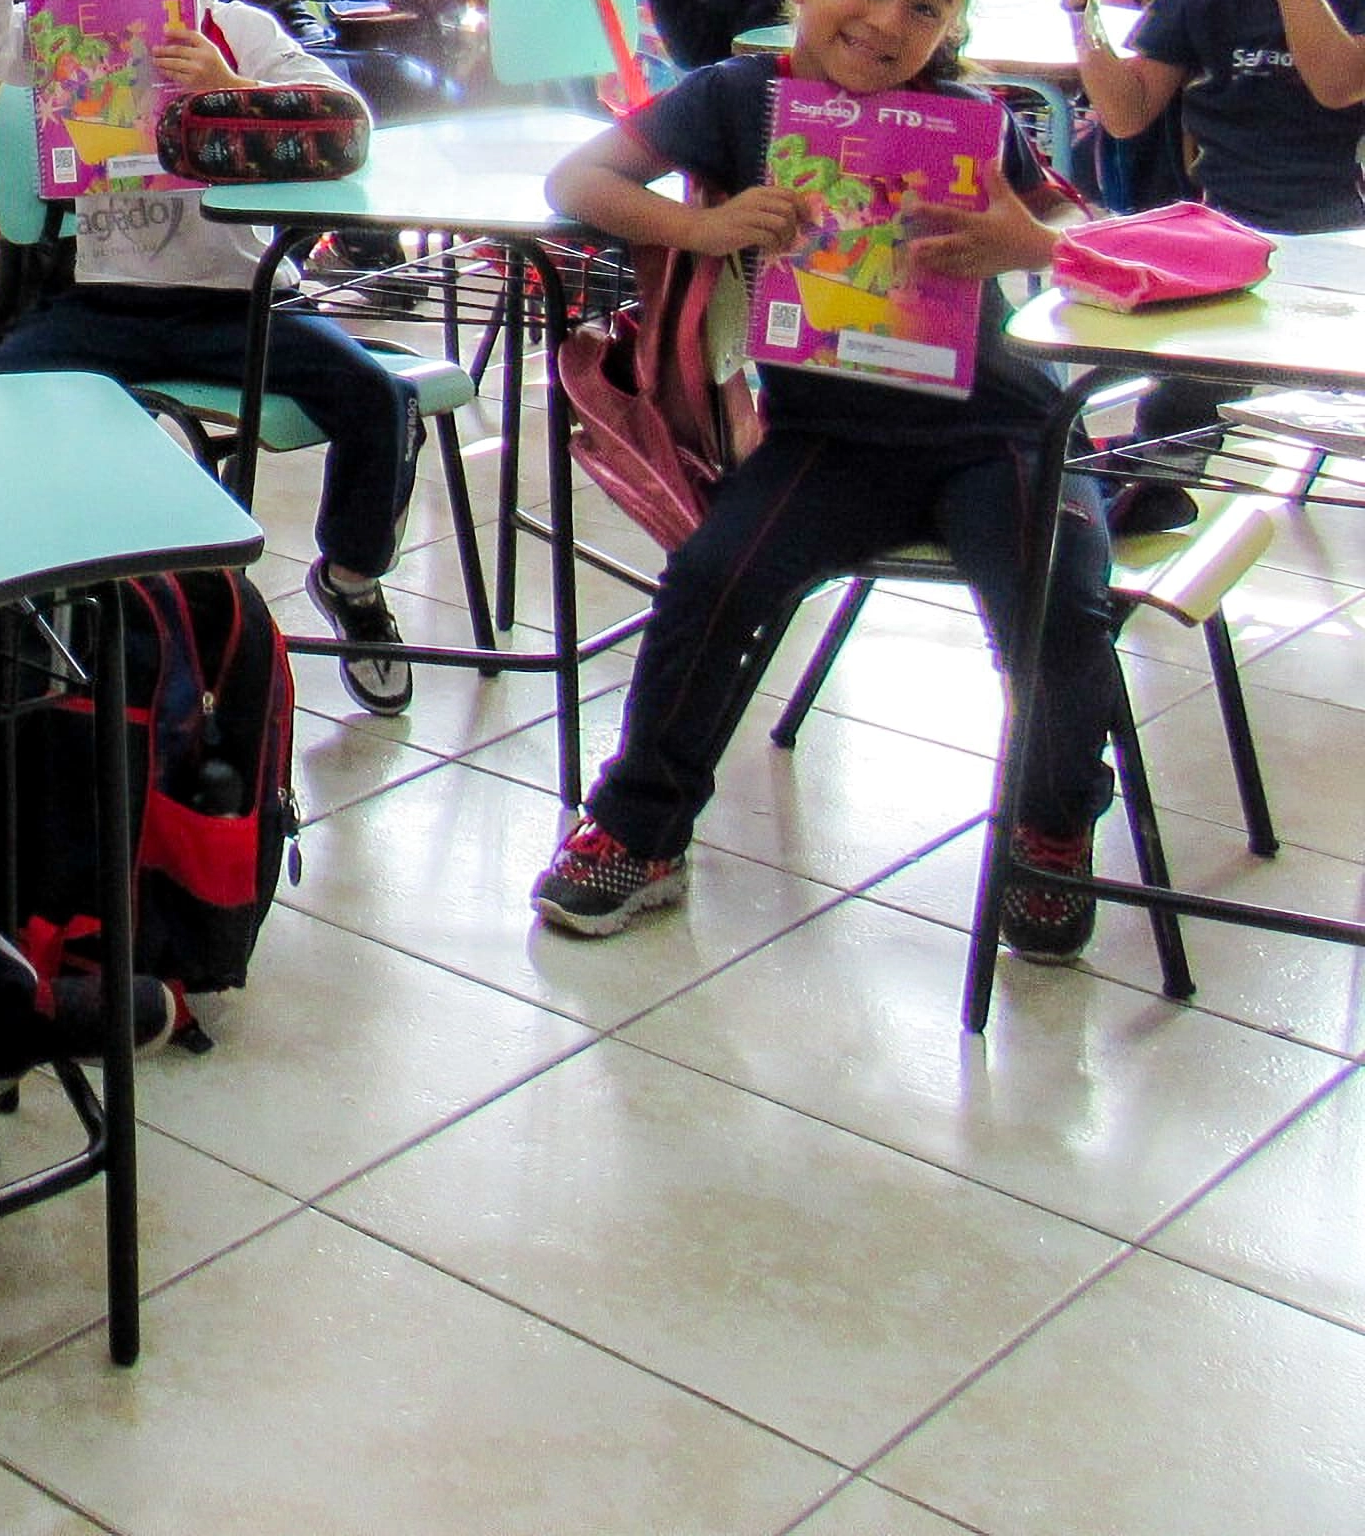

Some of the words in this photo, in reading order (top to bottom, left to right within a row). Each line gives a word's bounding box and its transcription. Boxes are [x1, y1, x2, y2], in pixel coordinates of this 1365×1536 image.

[162, 0, 187, 32] 1
[878, 107, 923, 127] FTD
[949, 155, 979, 196] 1
